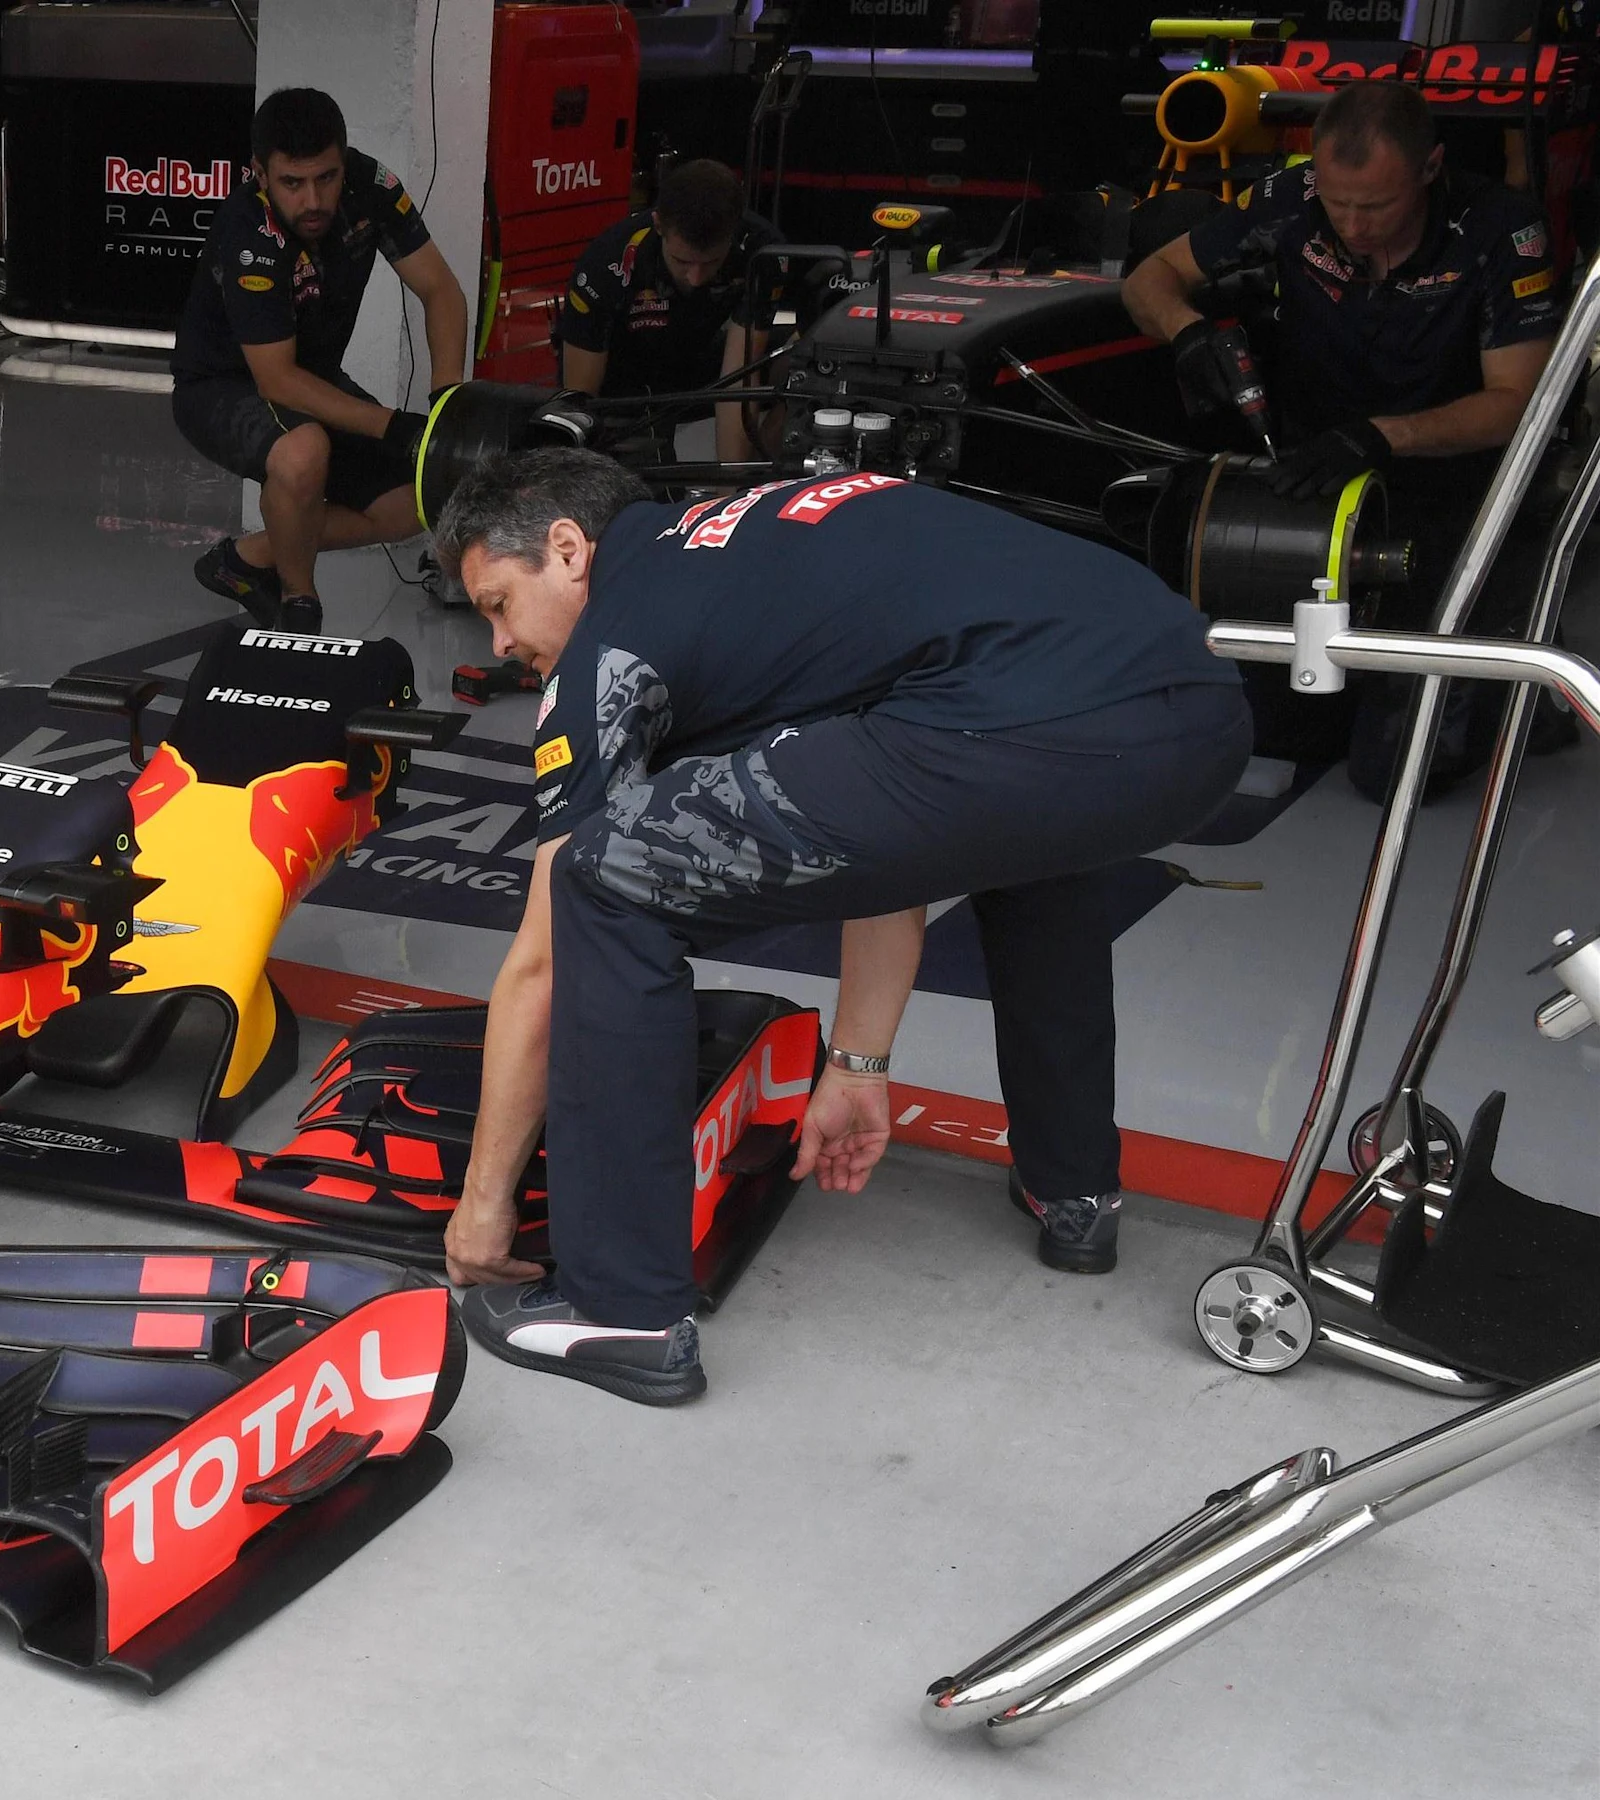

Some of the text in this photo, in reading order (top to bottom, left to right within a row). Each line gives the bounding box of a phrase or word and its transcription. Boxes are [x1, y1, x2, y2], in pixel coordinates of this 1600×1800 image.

[532, 157, 602, 195] TOTAL
[885, 211, 915, 222] RAUCH
[255, 256, 276, 266] AT&T
[631, 319, 668, 328] TOTAL
[788, 474, 914, 515] TOTA
[239, 628, 364, 657] PIRELLI
[205, 686, 331, 713] Hisense
[344, 848, 523, 898] ACING.
[693, 1044, 813, 1191] OTAL
[15, 1130, 60, 1143] ROAD
[60, 1138, 127, 1153] SAFETY
[26, 1127, 104, 1144] ACTION
[108, 1329, 439, 1565] TOTAL
